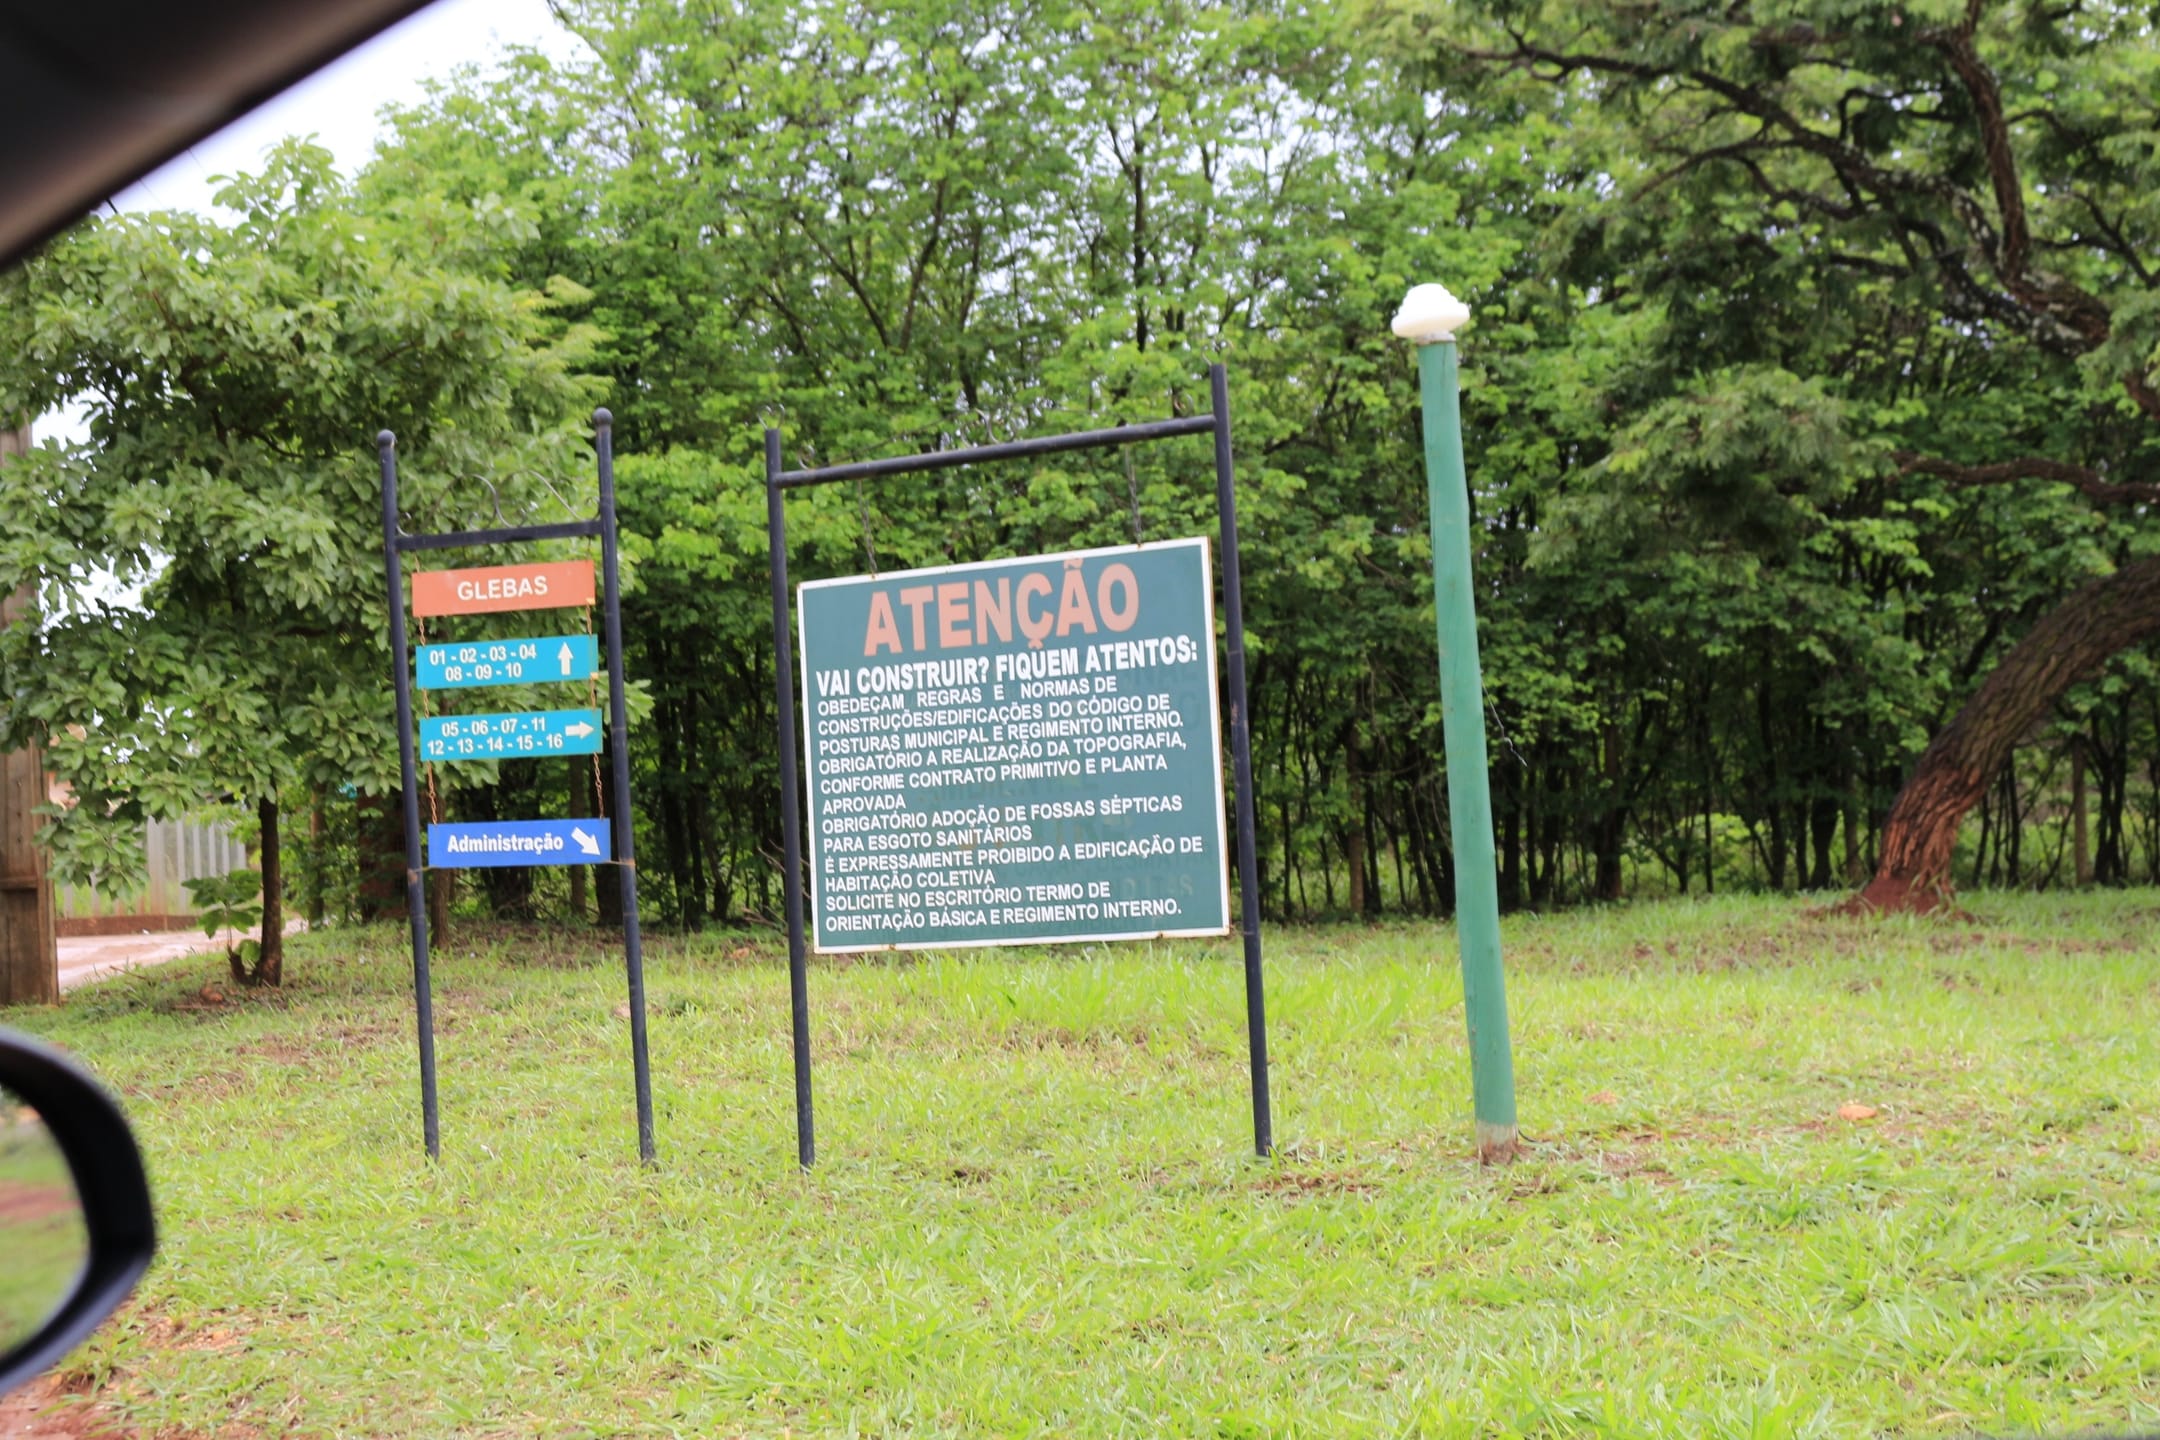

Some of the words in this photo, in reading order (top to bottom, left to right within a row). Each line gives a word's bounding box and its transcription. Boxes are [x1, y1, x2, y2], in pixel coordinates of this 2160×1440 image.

[457, 576, 548, 601] GLEBAS
[864, 558, 1140, 656] ATENÇÃO
[816, 670, 850, 697] VAI
[856, 657, 990, 694] CONSTRUIR?
[996, 647, 1078, 682] FIQUEM
[1085, 635, 1198, 672] ATENTOS:
[817, 694, 905, 716] OBEDEÇAM
[917, 687, 982, 708] REGRAS
[994, 685, 1004, 700] E
[1020, 678, 1090, 699] NORMAS
[1095, 676, 1117, 692] DE
[1049, 700, 1072, 717] DO
[1077, 695, 1143, 716] CÓDIGO
[1147, 694, 1170, 711] DE
[819, 735, 901, 756] POSTURAS
[904, 727, 988, 749] MUNICIPAL
[993, 726, 1003, 742] E
[1008, 718, 1102, 741] REGIMENTO
[1106, 710, 1183, 731] INTERNO.
[819, 751, 922, 774] OBRIGATÓRIO
[927, 748, 938, 765] A
[941, 741, 1043, 765] REALIZAÇÃO
[1047, 738, 1070, 756] DA
[1073, 732, 1187, 755] TOPOGRAFIA,
[820, 773, 905, 795] CONFORME
[909, 768, 996, 789] CONTRATO
[1000, 760, 1081, 780] PRIMITIVO
[1085, 759, 1096, 774] E
[1101, 754, 1168, 773] PLANTA
[822, 795, 906, 815] APROVADA
[822, 811, 927, 834] OBRIGATÓRIO
[932, 804, 1000, 828] ADOÇÃO
[1004, 805, 1026, 822] DE
[1031, 799, 1095, 819] FOSSAS
[1099, 795, 1183, 815] SÉPTICAS
[448, 834, 564, 856] Administração
[823, 836, 865, 853] PARA
[868, 831, 932, 849] ESGOTO
[936, 823, 1033, 847] SANITÁRIOS
[825, 853, 834, 873] É
[838, 850, 973, 872] EXPRESSAMENTE
[977, 847, 1054, 865] PROIBIDO
[1058, 844, 1070, 861] A
[1074, 836, 1176, 860] EDIFICAÇÃO
[1180, 836, 1203, 853] DE
[825, 872, 913, 893] HABITAÇÃO
[917, 869, 995, 888] COLETIVA
[826, 891, 894, 912] SOLICITE
[898, 892, 921, 908] NO
[925, 885, 1022, 907] ESCRITÓRIO
[1027, 883, 1083, 900] TERMO
[1088, 881, 1111, 898] DE
[826, 907, 926, 932] ORIENTAÇÃO
[930, 907, 987, 927] BÁSICA
[990, 908, 1000, 924] E
[1003, 904, 1099, 924] REGIMENTO
[1103, 898, 1182, 918] INTERNO.
